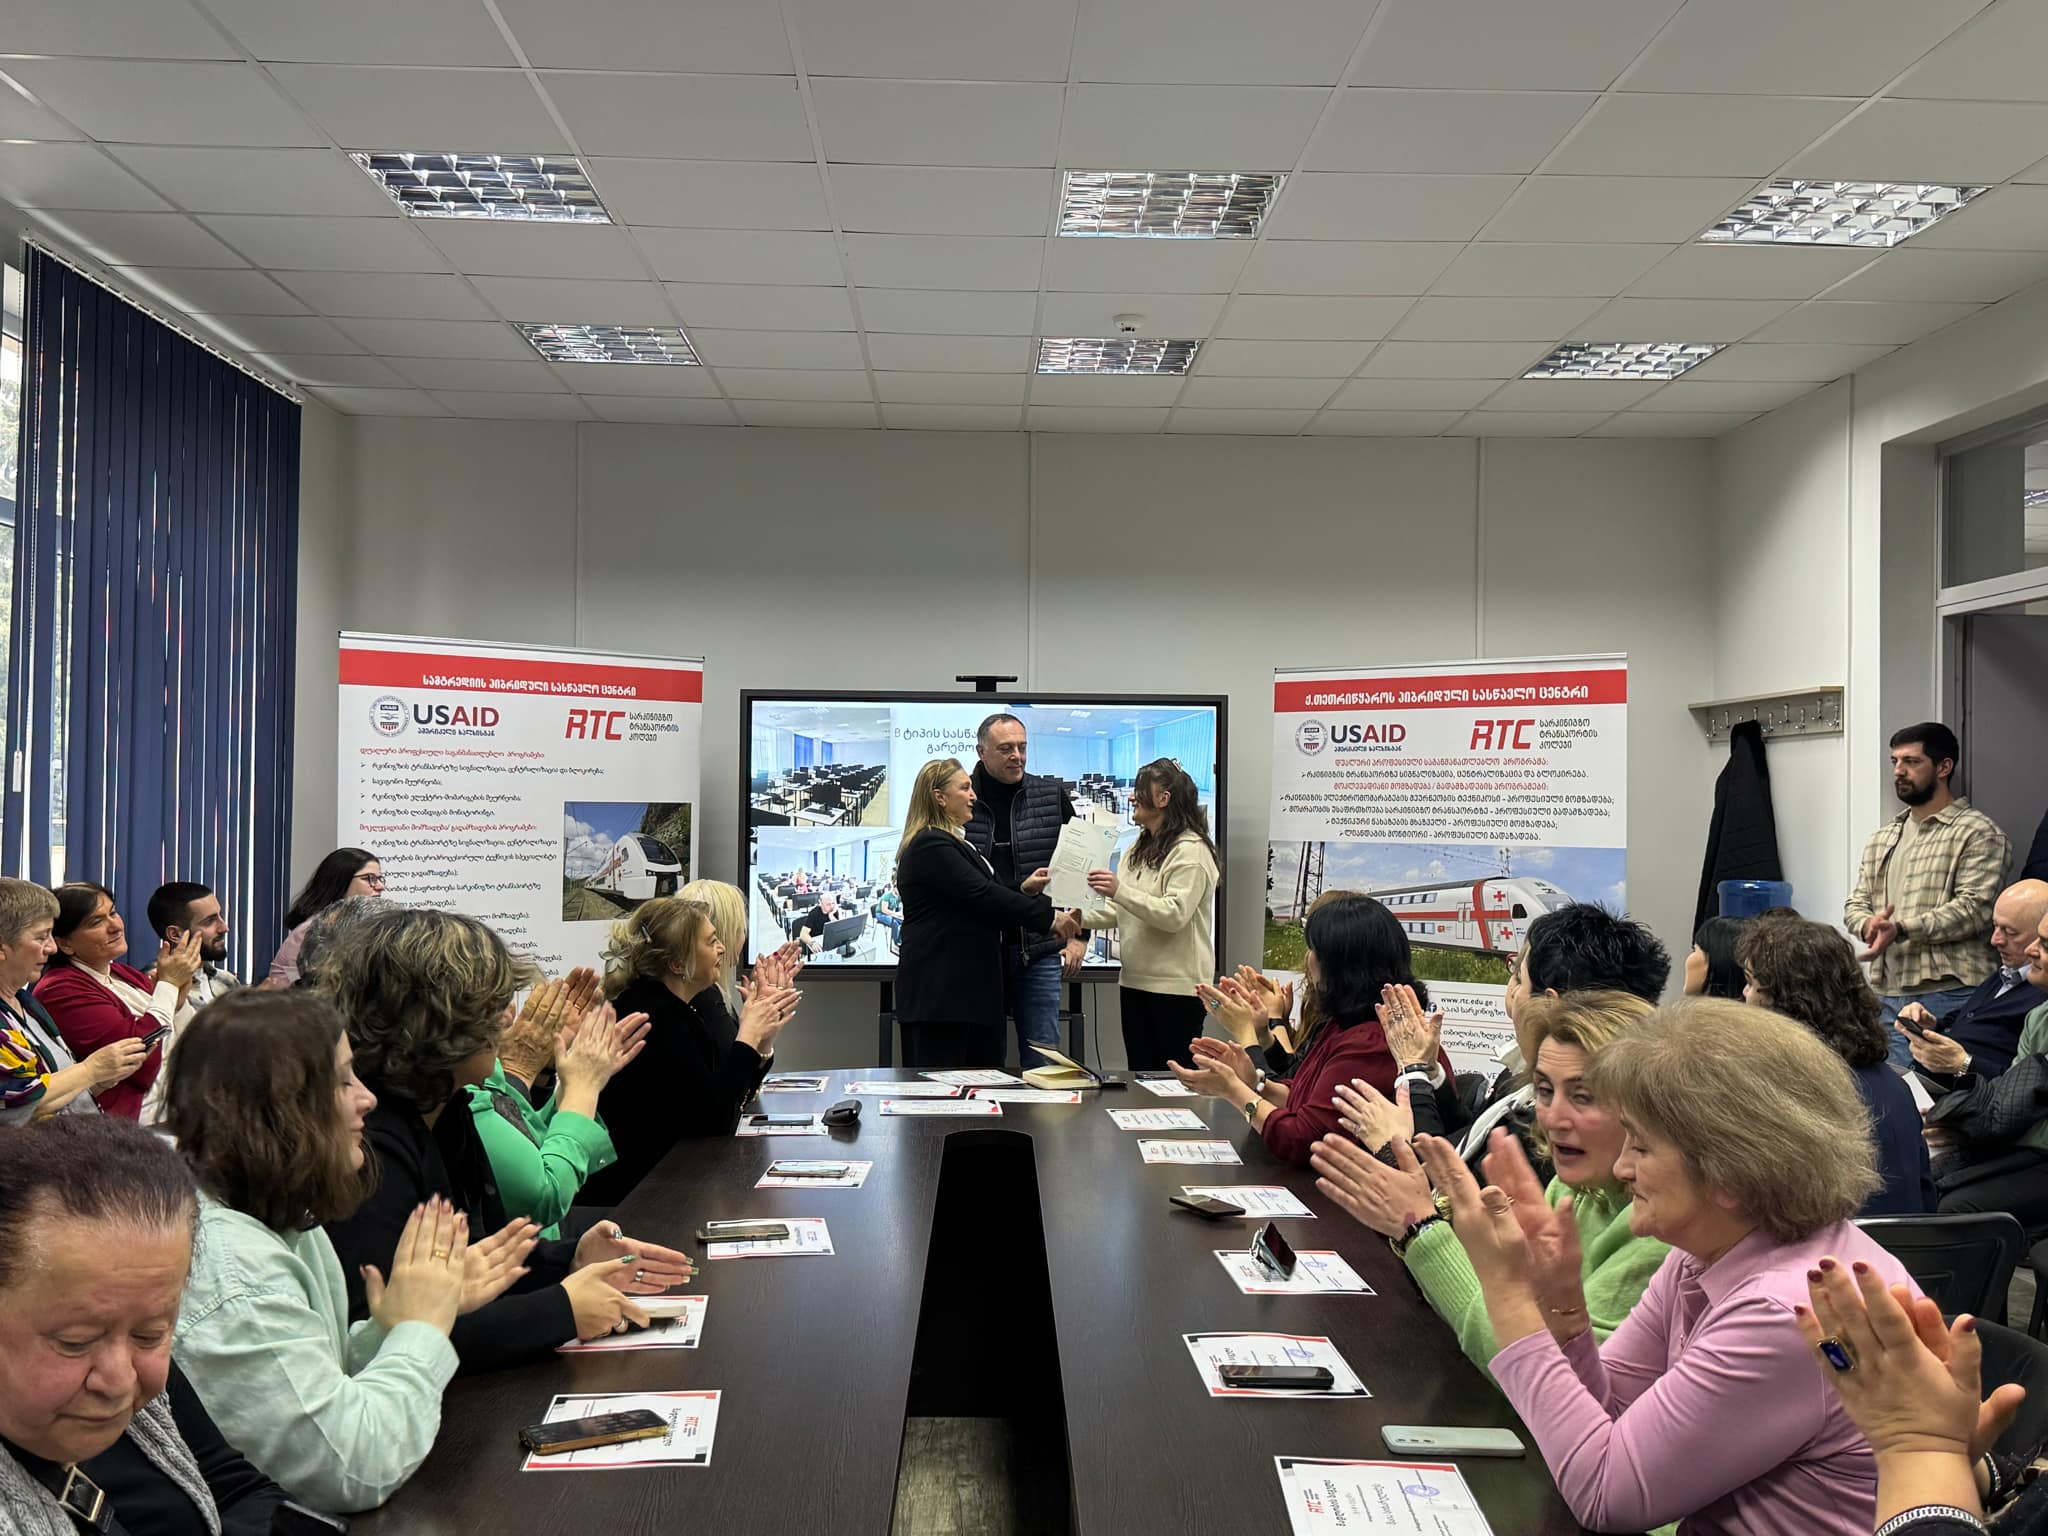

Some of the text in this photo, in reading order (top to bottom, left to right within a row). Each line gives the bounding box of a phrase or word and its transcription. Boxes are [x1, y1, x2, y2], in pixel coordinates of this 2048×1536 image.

[489, 679, 549, 692] ჰიბრიდული
[551, 682, 599, 695] სასწავლო
[601, 685, 637, 697] ცენტრი
[1398, 688, 1469, 703] ჰიბრიდული
[1472, 687, 1536, 701] სასწავლო
[1539, 686, 1589, 699] ცენტრი
[413, 704, 500, 727] USAID
[1539, 718, 1590, 728] სარკინიგზო
[565, 708, 626, 740] RTC
[903, 727, 940, 740] ტიპის
[942, 728, 977, 738] სასწა
[1331, 724, 1406, 743] USAID
[1470, 719, 1536, 750] RTC
[1539, 729, 1598, 738] ტრანსპორტის
[926, 741, 975, 754] გარემო
[1539, 740, 1572, 749] კოლეჯი
[1524, 770, 1535, 778] და
